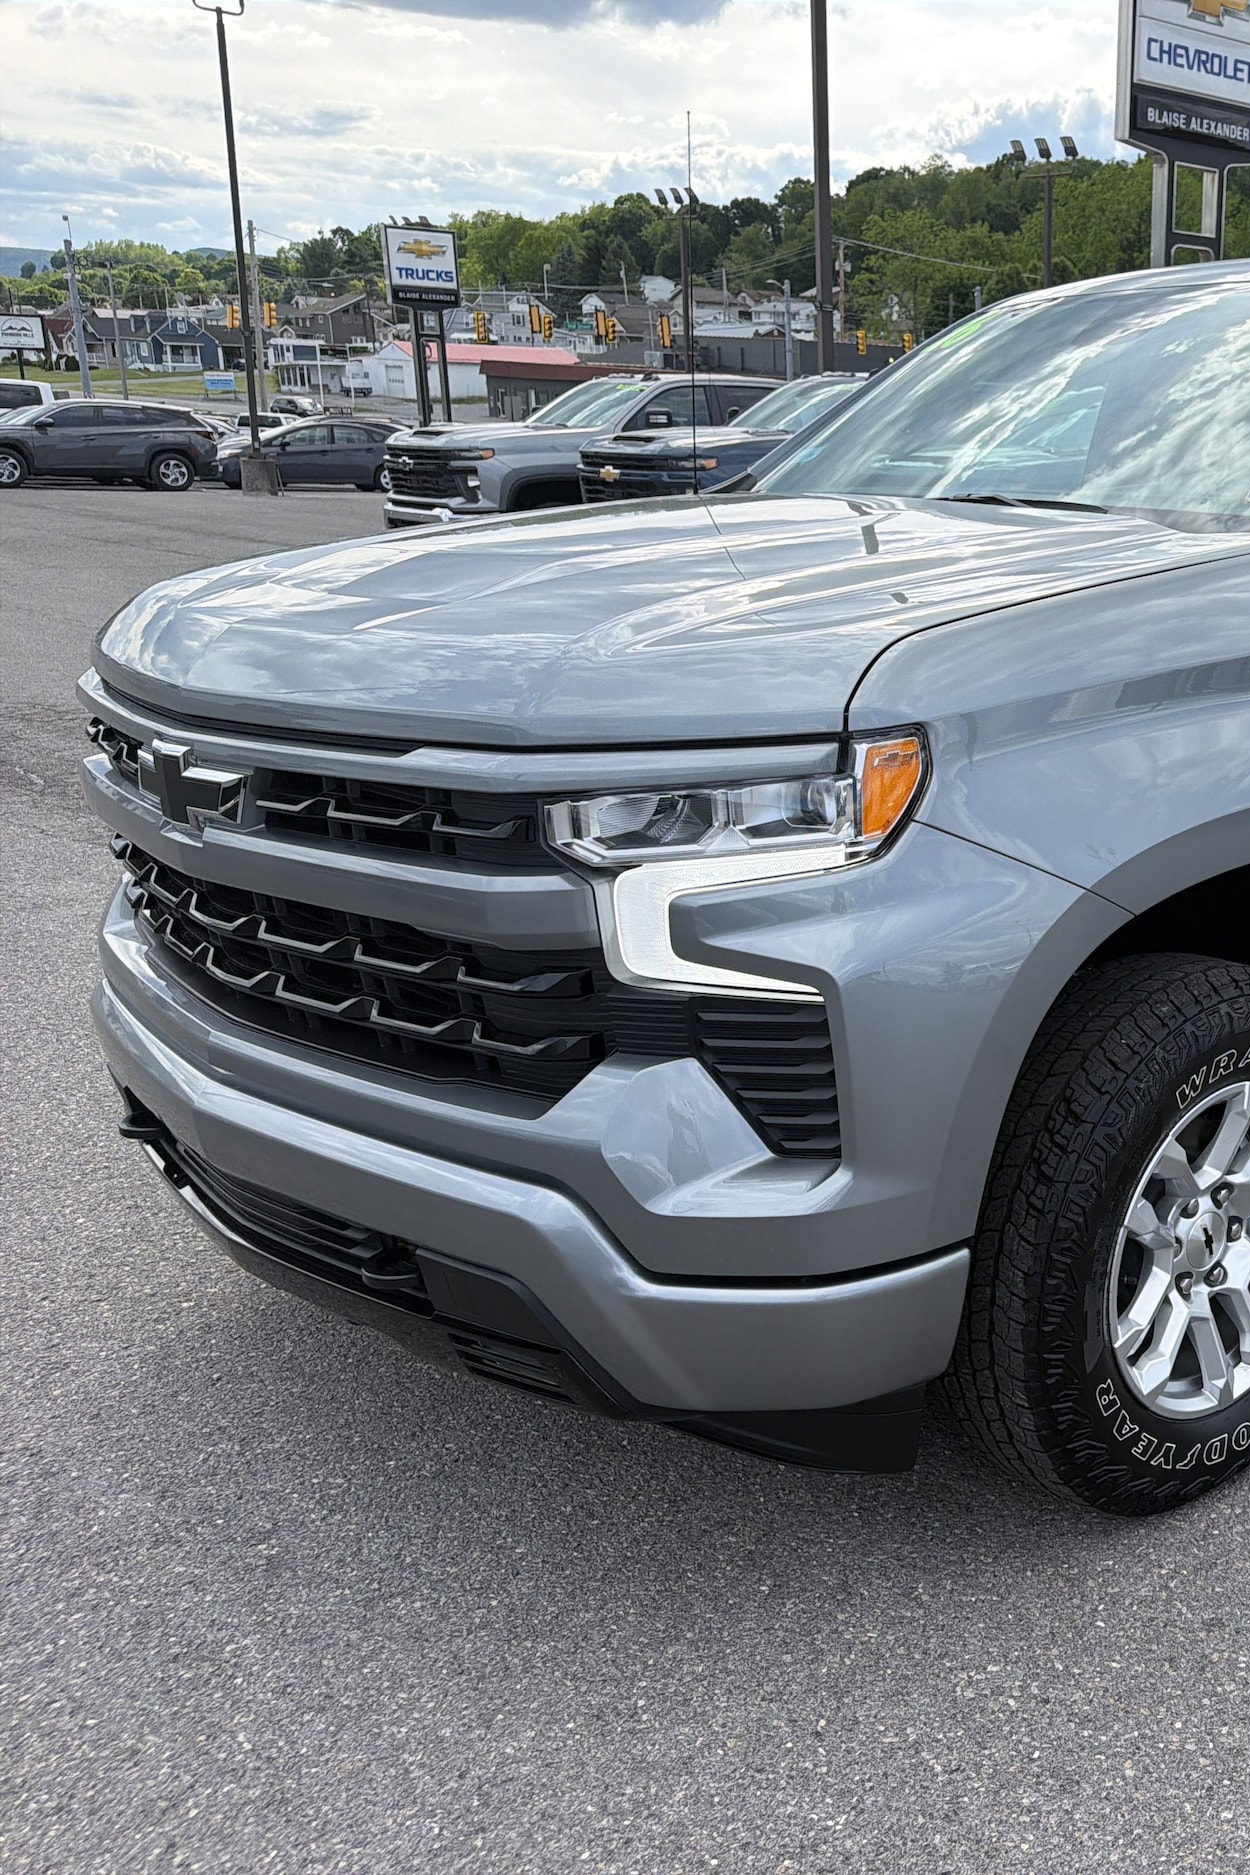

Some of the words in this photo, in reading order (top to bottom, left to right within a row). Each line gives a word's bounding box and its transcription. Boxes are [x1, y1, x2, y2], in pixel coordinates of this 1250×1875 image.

[1147, 107, 1187, 129] BLAISE
[1190, 116, 1250, 142] ALEXANDER
[395, 266, 454, 282] TRUCKS
[398, 291, 420, 299] BLAISE
[422, 293, 456, 301] ALEXANDER
